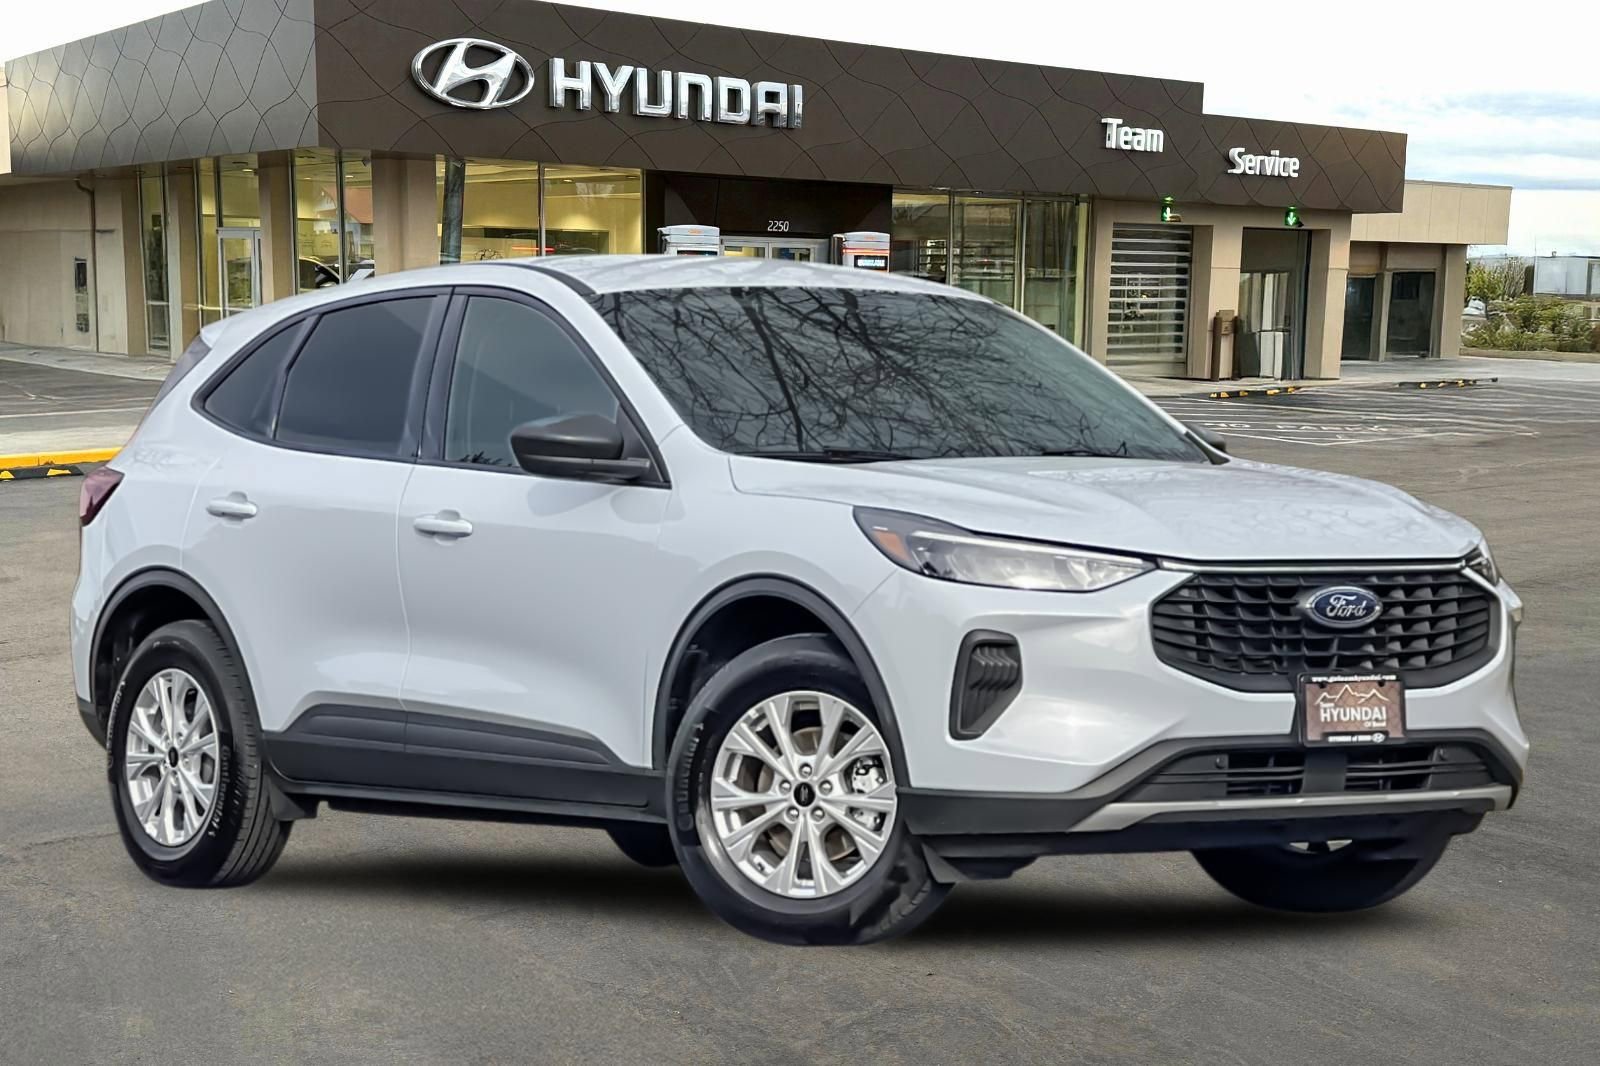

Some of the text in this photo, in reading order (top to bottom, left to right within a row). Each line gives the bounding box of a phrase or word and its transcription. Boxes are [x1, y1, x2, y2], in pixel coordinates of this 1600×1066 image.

[548, 57, 804, 129] HYUNDAI
[1101, 117, 1164, 153] Team
[1227, 147, 1300, 178] Service
[767, 220, 790, 232] 2250
[1326, 594, 1368, 617] Ford
[1320, 706, 1387, 722] HYUNDAI
